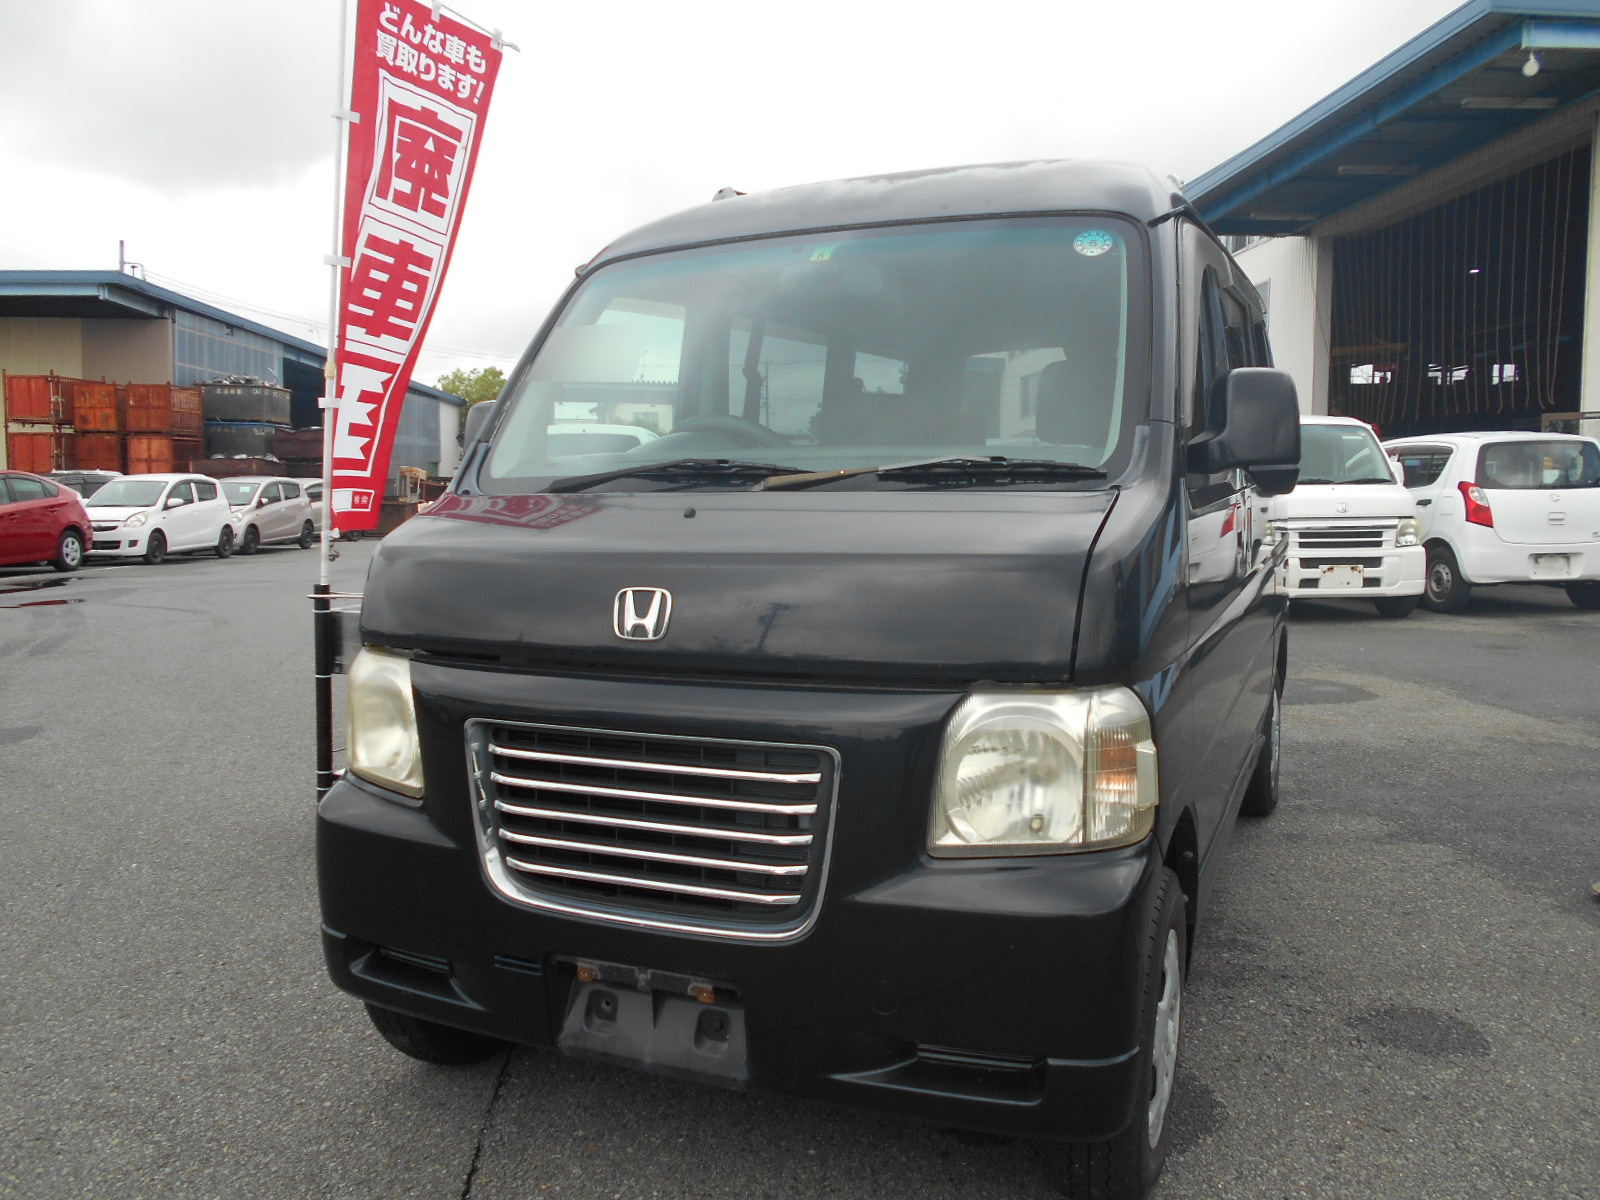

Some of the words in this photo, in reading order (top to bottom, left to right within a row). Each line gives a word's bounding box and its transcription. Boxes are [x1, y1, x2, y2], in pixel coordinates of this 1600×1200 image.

[379, 2, 486, 73] どんな車も
